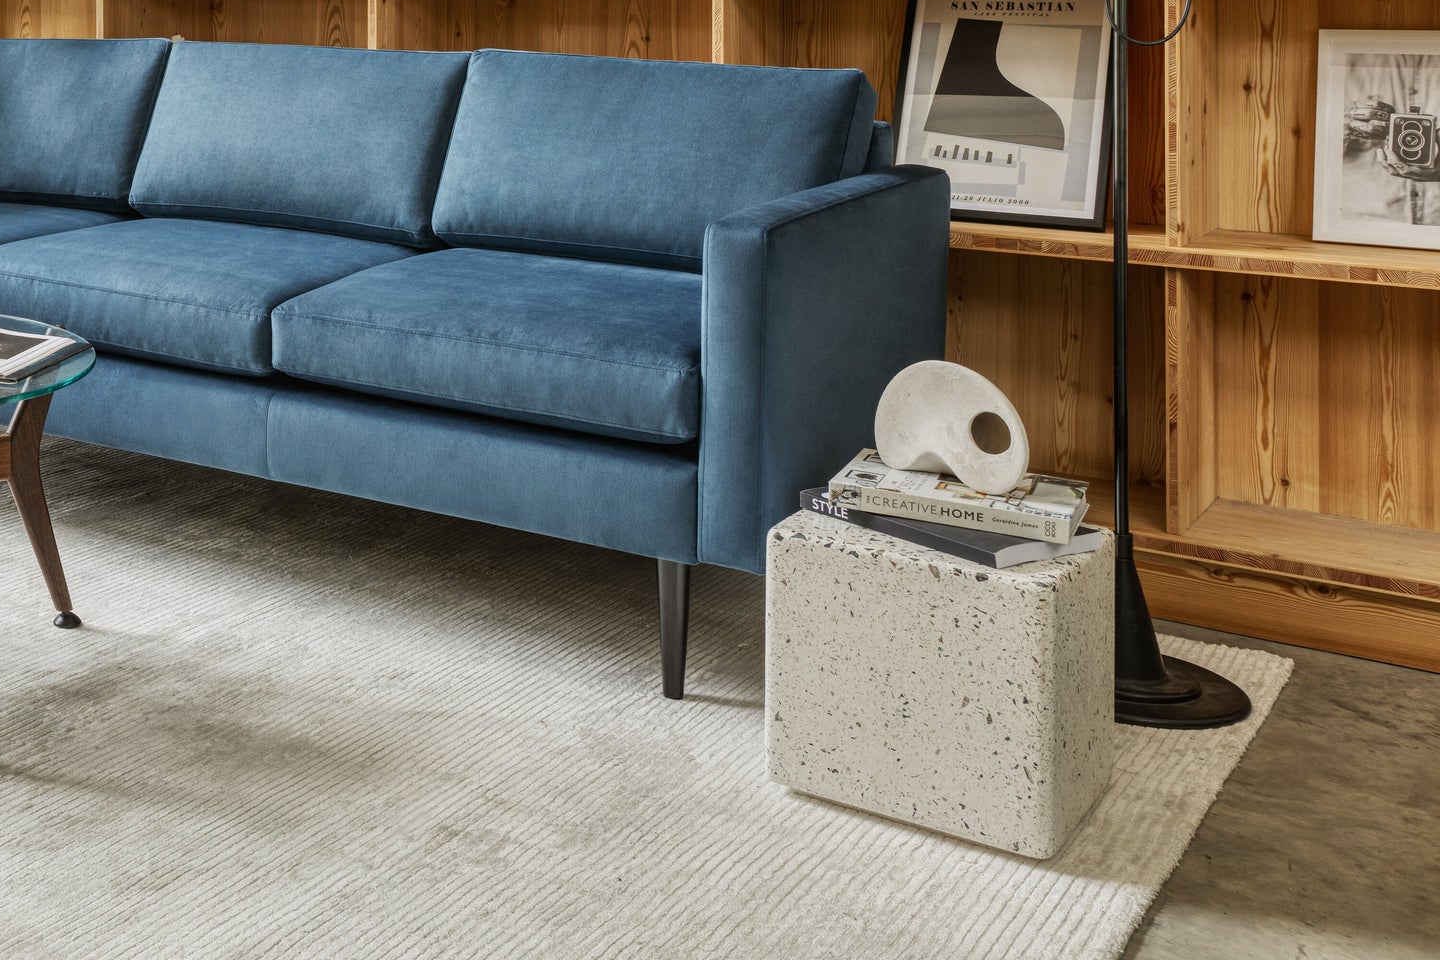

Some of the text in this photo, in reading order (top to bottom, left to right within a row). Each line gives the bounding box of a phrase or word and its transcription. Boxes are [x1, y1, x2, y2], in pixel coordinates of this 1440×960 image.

[951, 1, 1076, 12] SAN SEBASTIAN
[812, 498, 849, 520] STYLE
[872, 496, 938, 516] CREATIVE
[940, 506, 984, 523] HOME
[992, 516, 1020, 526] Geraldine
